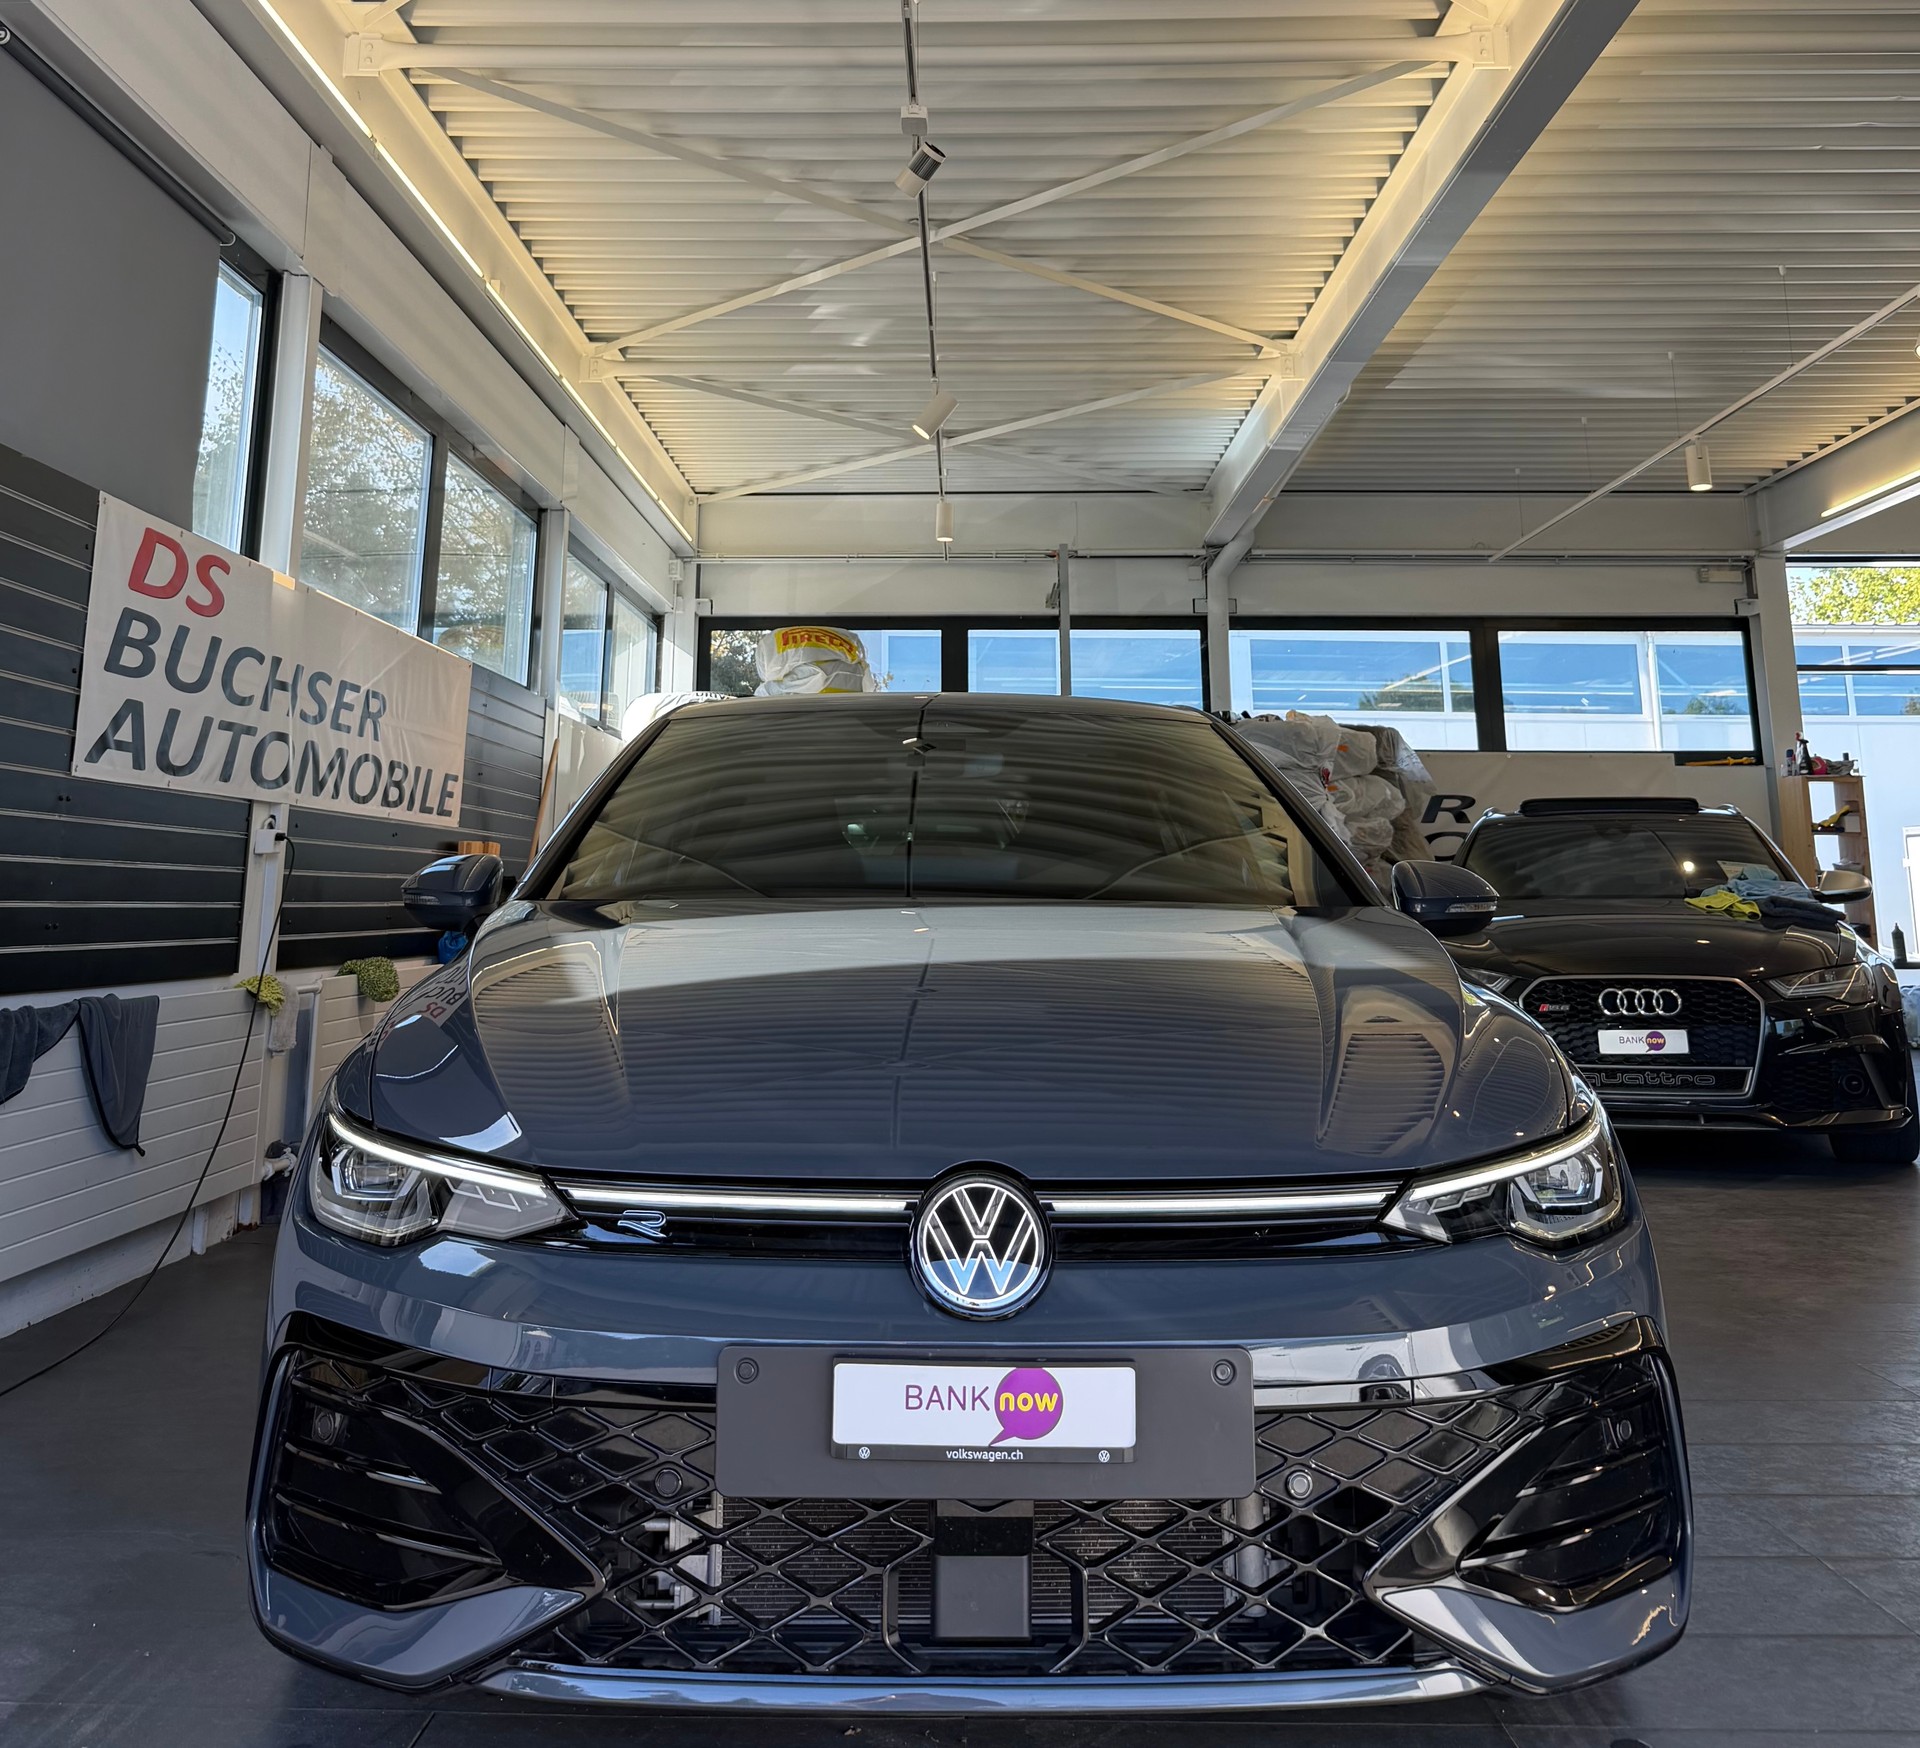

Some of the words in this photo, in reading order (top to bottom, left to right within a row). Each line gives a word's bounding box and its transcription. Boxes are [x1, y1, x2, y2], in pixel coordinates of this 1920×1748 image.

[127, 526, 231, 618] DS
[781, 627, 856, 653] PIREL
[103, 606, 388, 742] BUCHSER
[84, 698, 460, 818] AUTOMOBILE
[1618, 1036, 1645, 1044] BANK
[1583, 1071, 1716, 1087] quattro
[905, 1384, 990, 1411] BANK
[999, 1391, 1058, 1412] now
[946, 1448, 1024, 1462] volkswagen.ch
